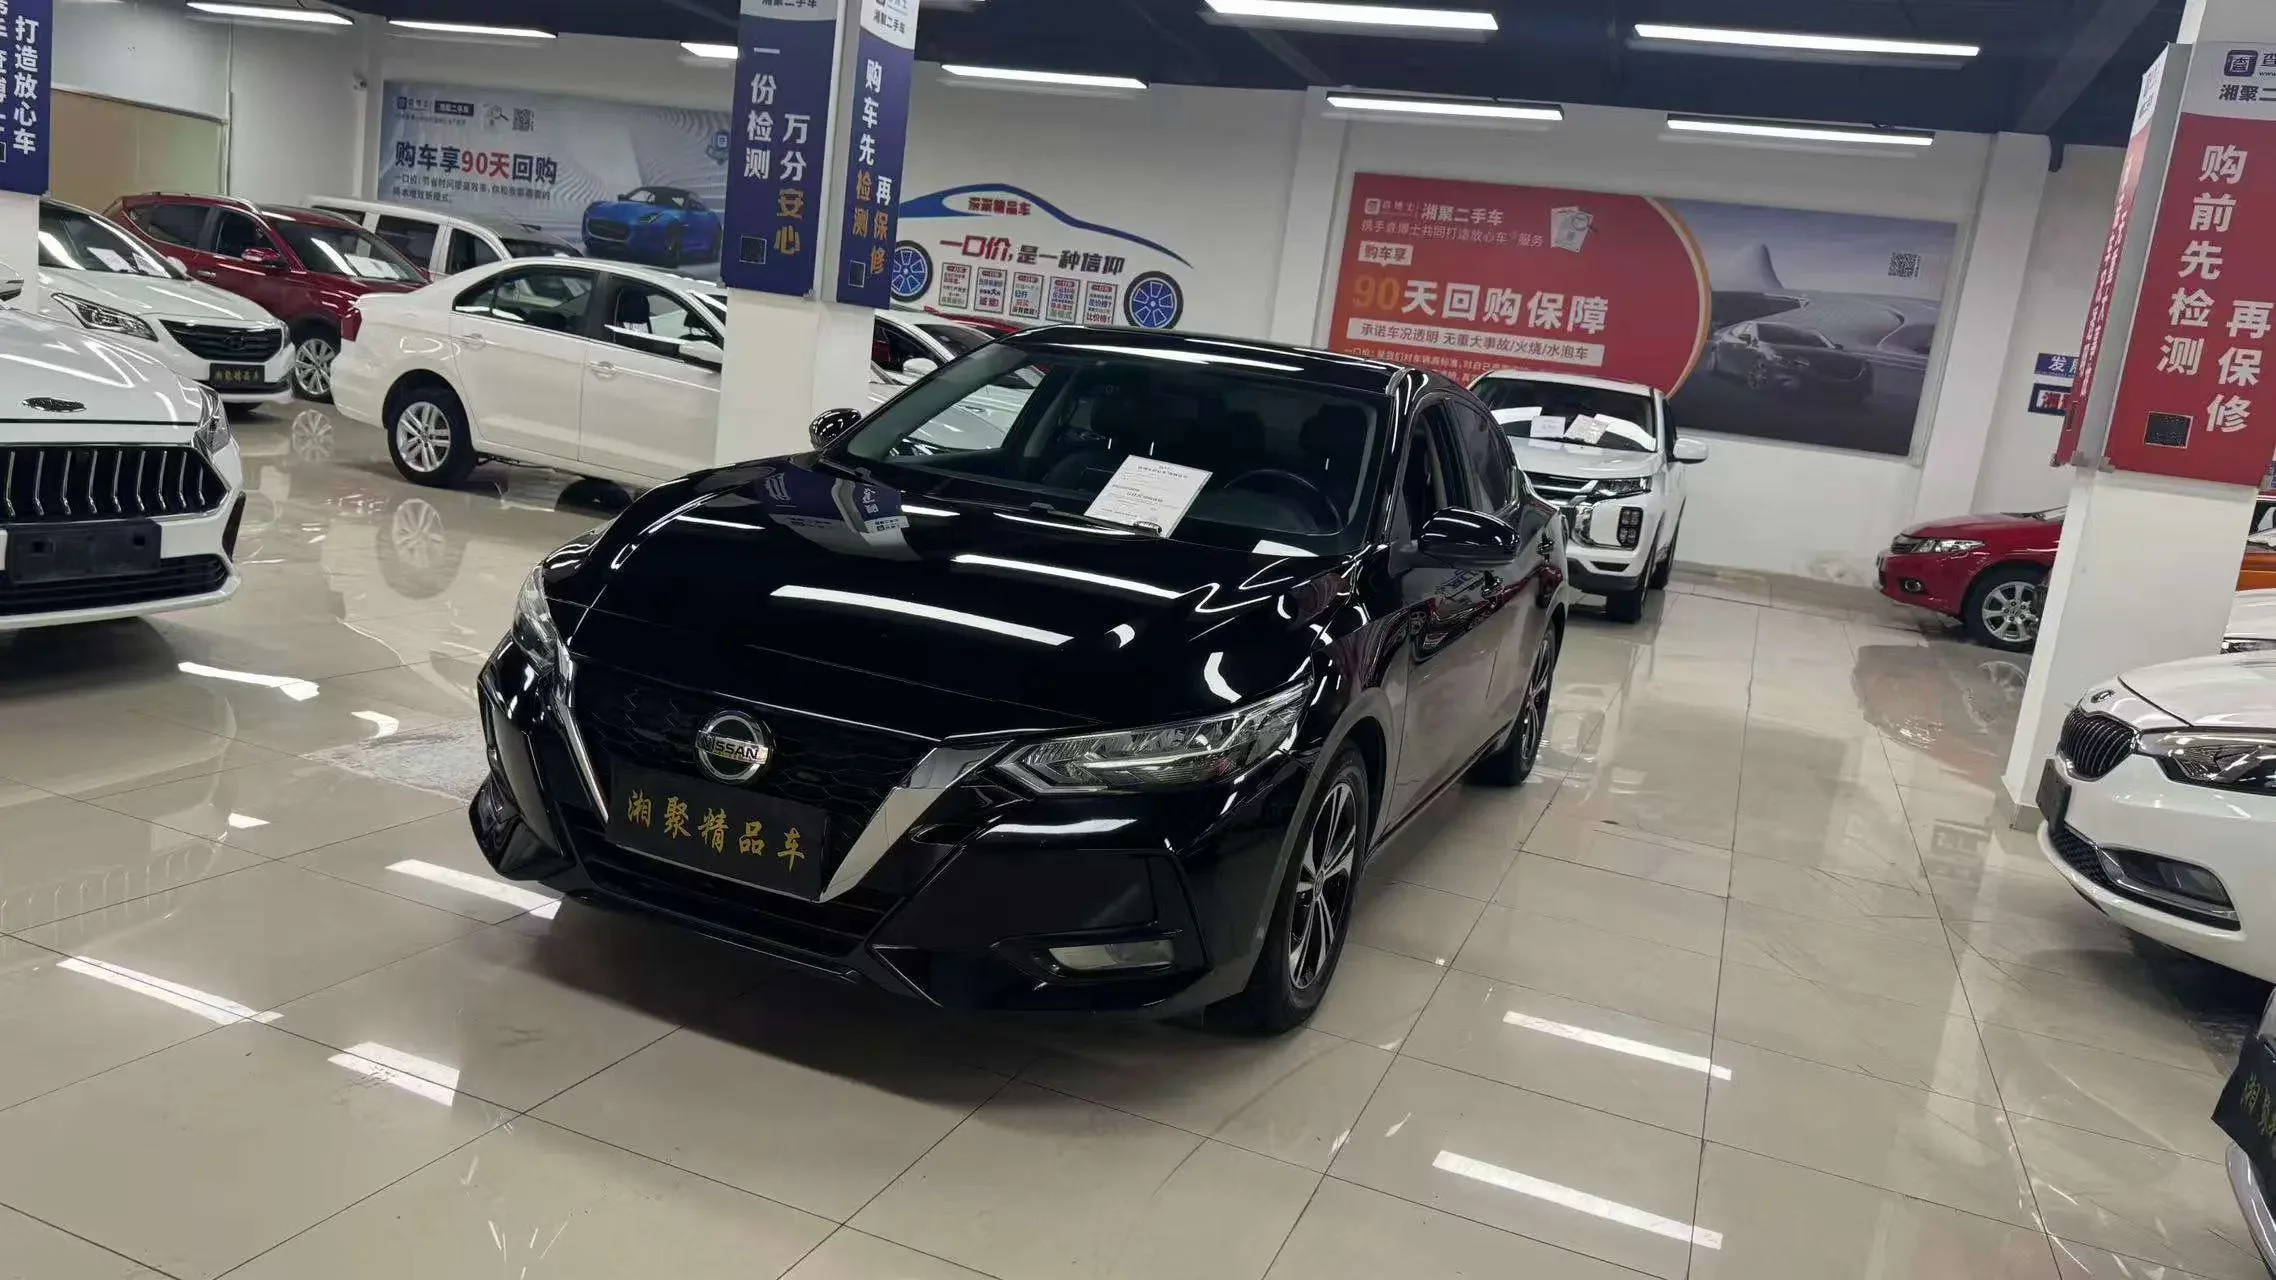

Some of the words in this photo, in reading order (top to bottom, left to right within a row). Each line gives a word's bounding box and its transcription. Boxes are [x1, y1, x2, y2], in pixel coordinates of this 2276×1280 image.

[13, 15, 40, 155] 打造放心车
[743, 47, 780, 180] 一份检测
[395, 140, 558, 185] 购车享90天回购
[774, 113, 810, 256] 万分安心
[852, 59, 883, 238] 购车先检测
[869, 175, 893, 275] 再保修
[1363, 244, 1408, 260] 购车享
[2157, 144, 2248, 376] 购前先检测
[1352, 274, 1609, 335] 90天回购保障
[1360, 322, 1439, 344] 承诺车况透明
[1443, 331, 1589, 360] 无重大事故/火烧/水泡车
[2206, 300, 2274, 433] 再保修
[700, 735, 759, 760] NISSAN
[627, 790, 805, 873] 湘聚精品车
